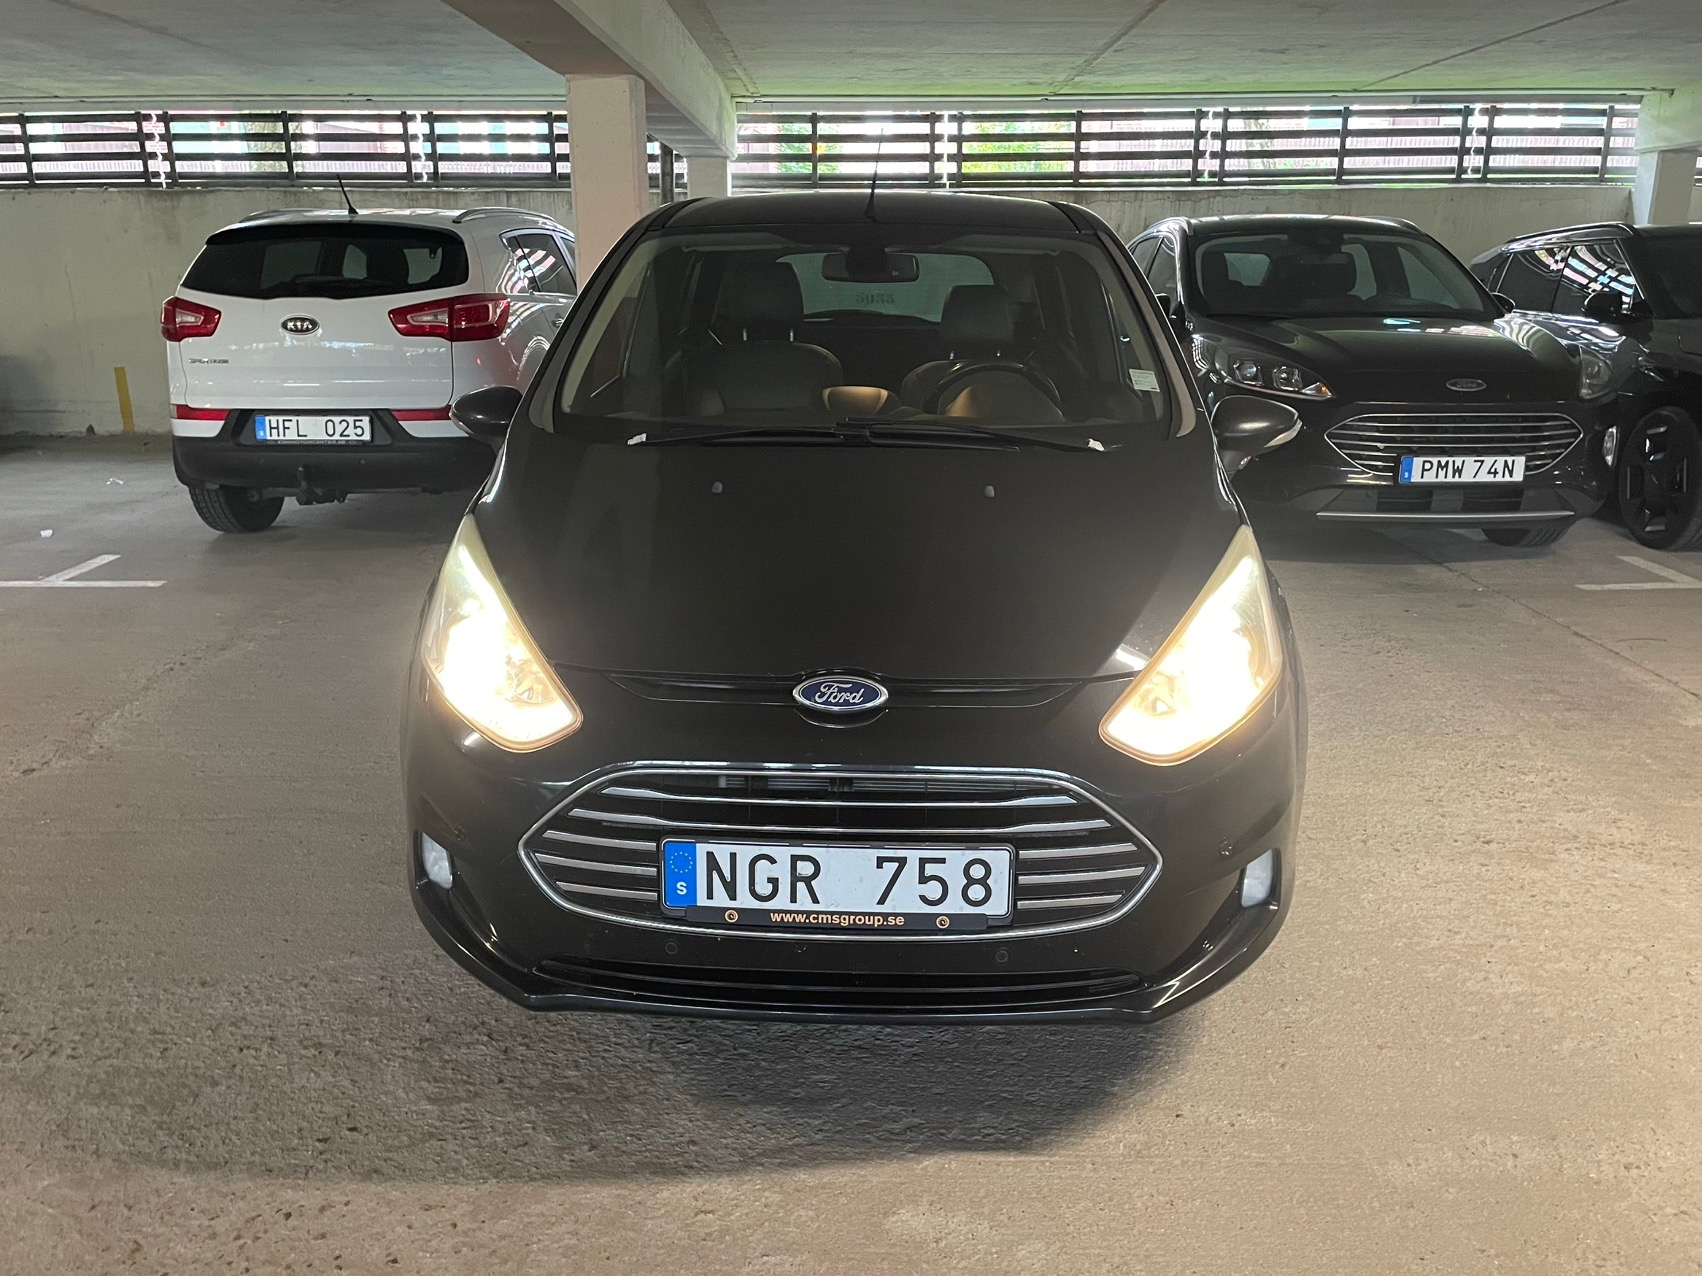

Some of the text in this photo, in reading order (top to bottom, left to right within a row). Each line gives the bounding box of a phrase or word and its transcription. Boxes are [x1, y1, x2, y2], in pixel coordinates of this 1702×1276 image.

[268, 419, 307, 437] HFL
[325, 419, 365, 437] 025
[1420, 460, 1465, 479] PMW
[1473, 459, 1516, 479] 74N
[815, 682, 865, 703] Ford
[676, 851, 992, 907] S NGR 758
[770, 912, 905, 927] www.cmsgroup.se
